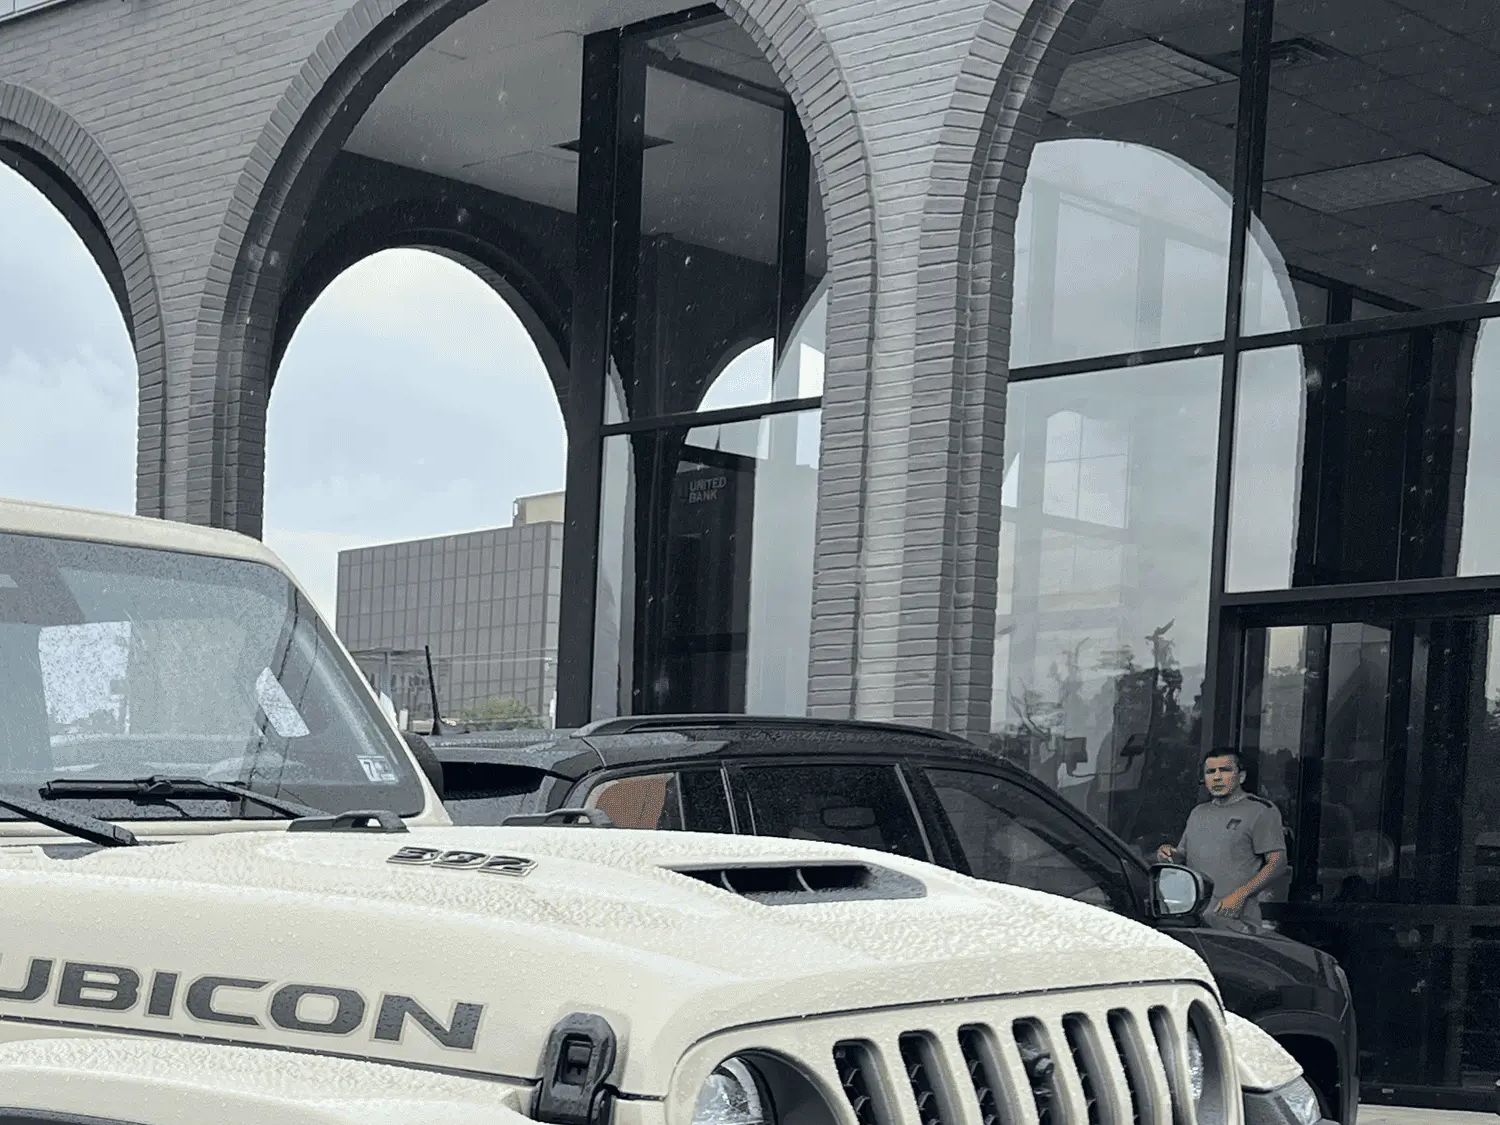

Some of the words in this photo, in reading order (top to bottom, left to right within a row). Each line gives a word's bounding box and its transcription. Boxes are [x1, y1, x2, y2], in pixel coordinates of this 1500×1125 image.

[689, 476, 727, 492] UNITED
[688, 489, 718, 503] BANK
[386, 846, 538, 877] 392
